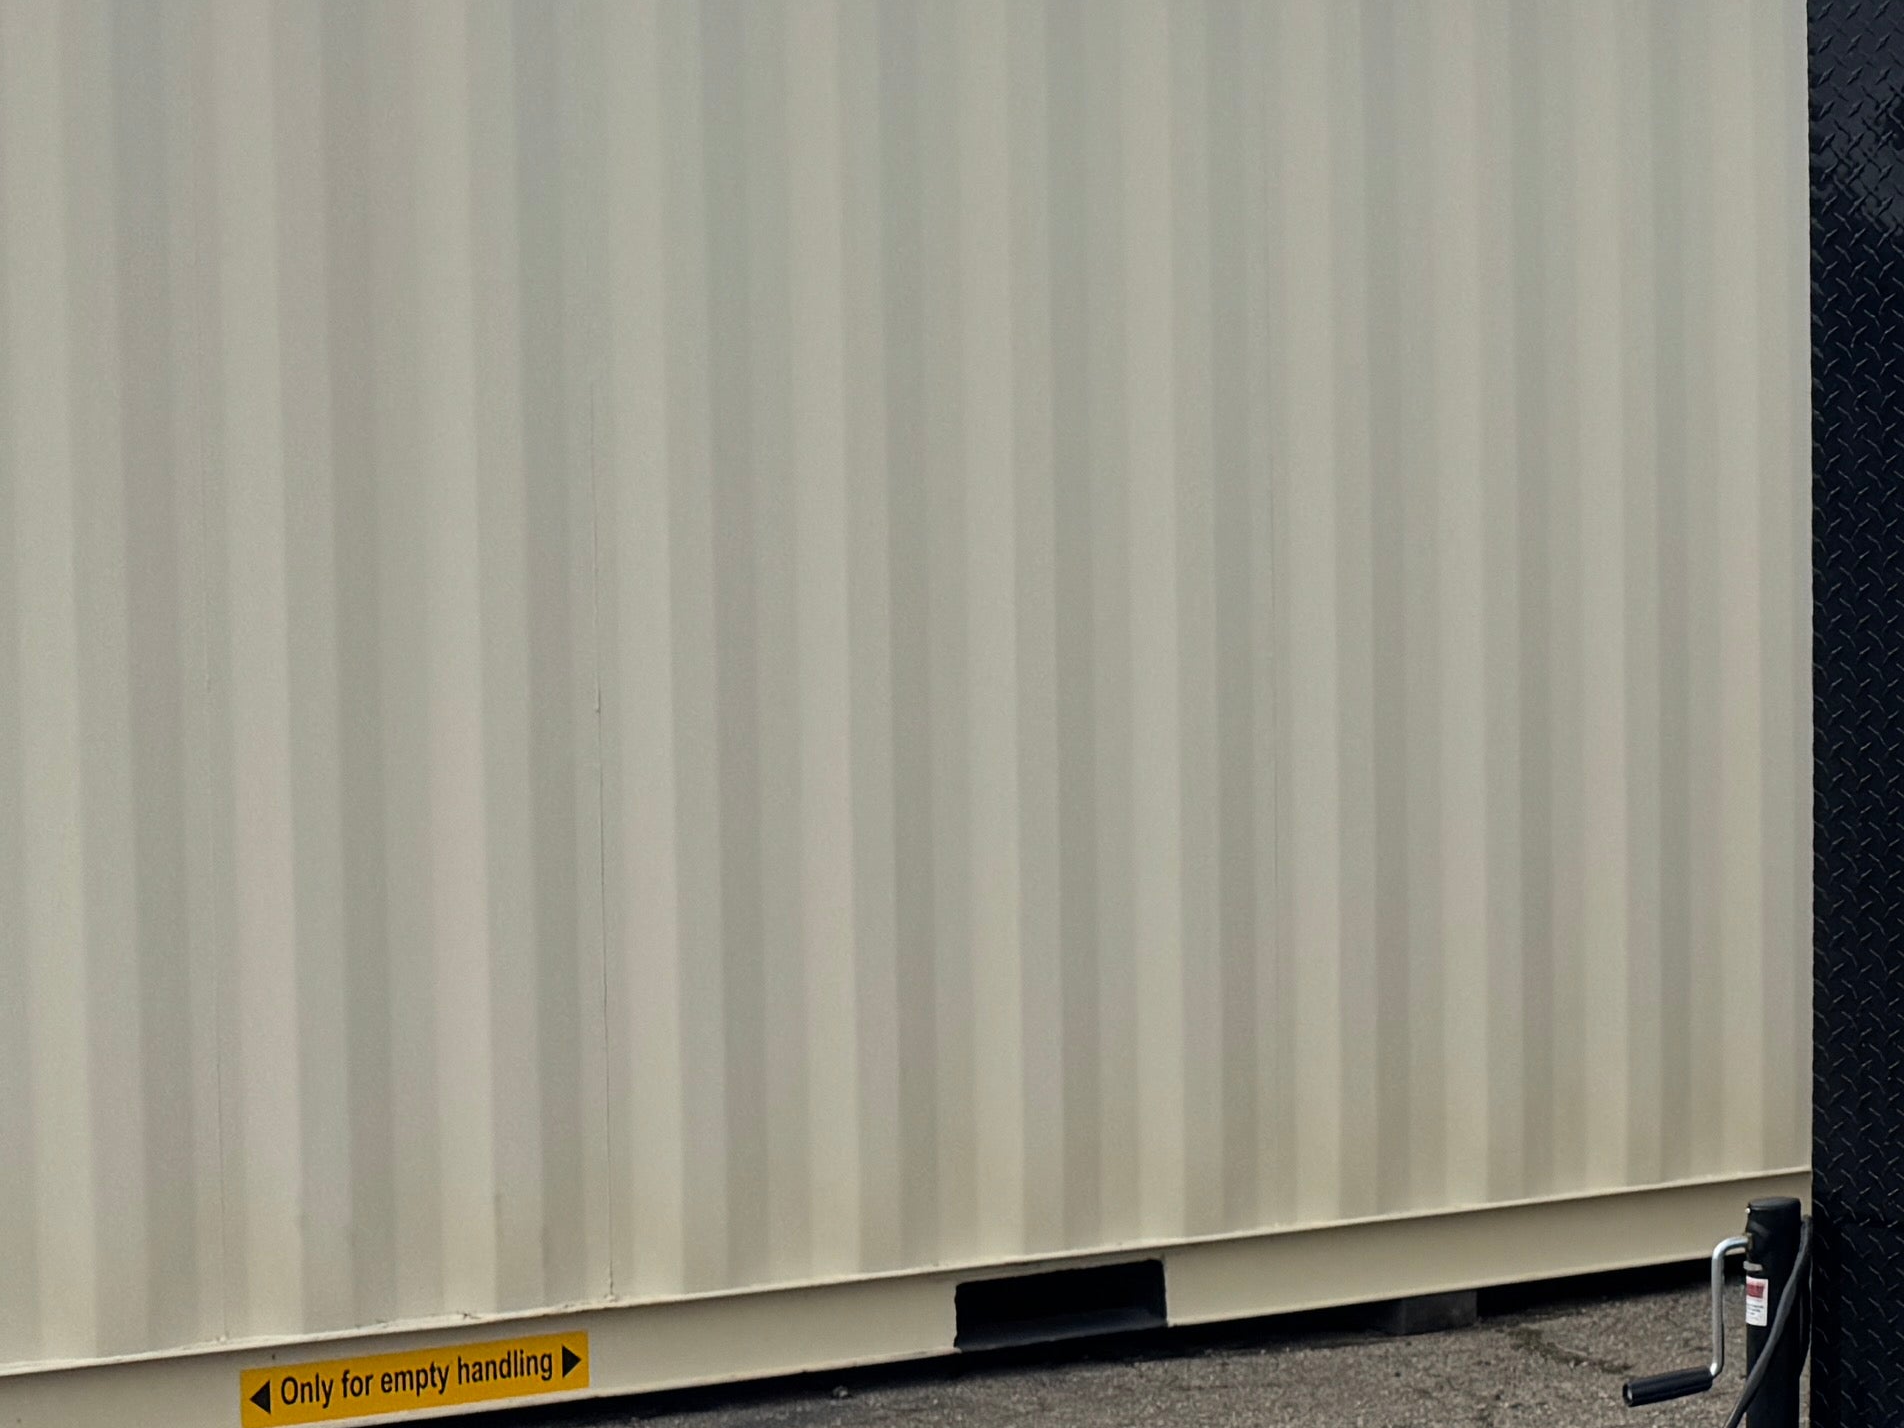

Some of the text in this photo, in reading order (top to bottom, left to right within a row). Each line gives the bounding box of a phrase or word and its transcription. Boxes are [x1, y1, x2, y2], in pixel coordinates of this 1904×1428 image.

[280, 1348, 553, 1409] Only for empty handling
